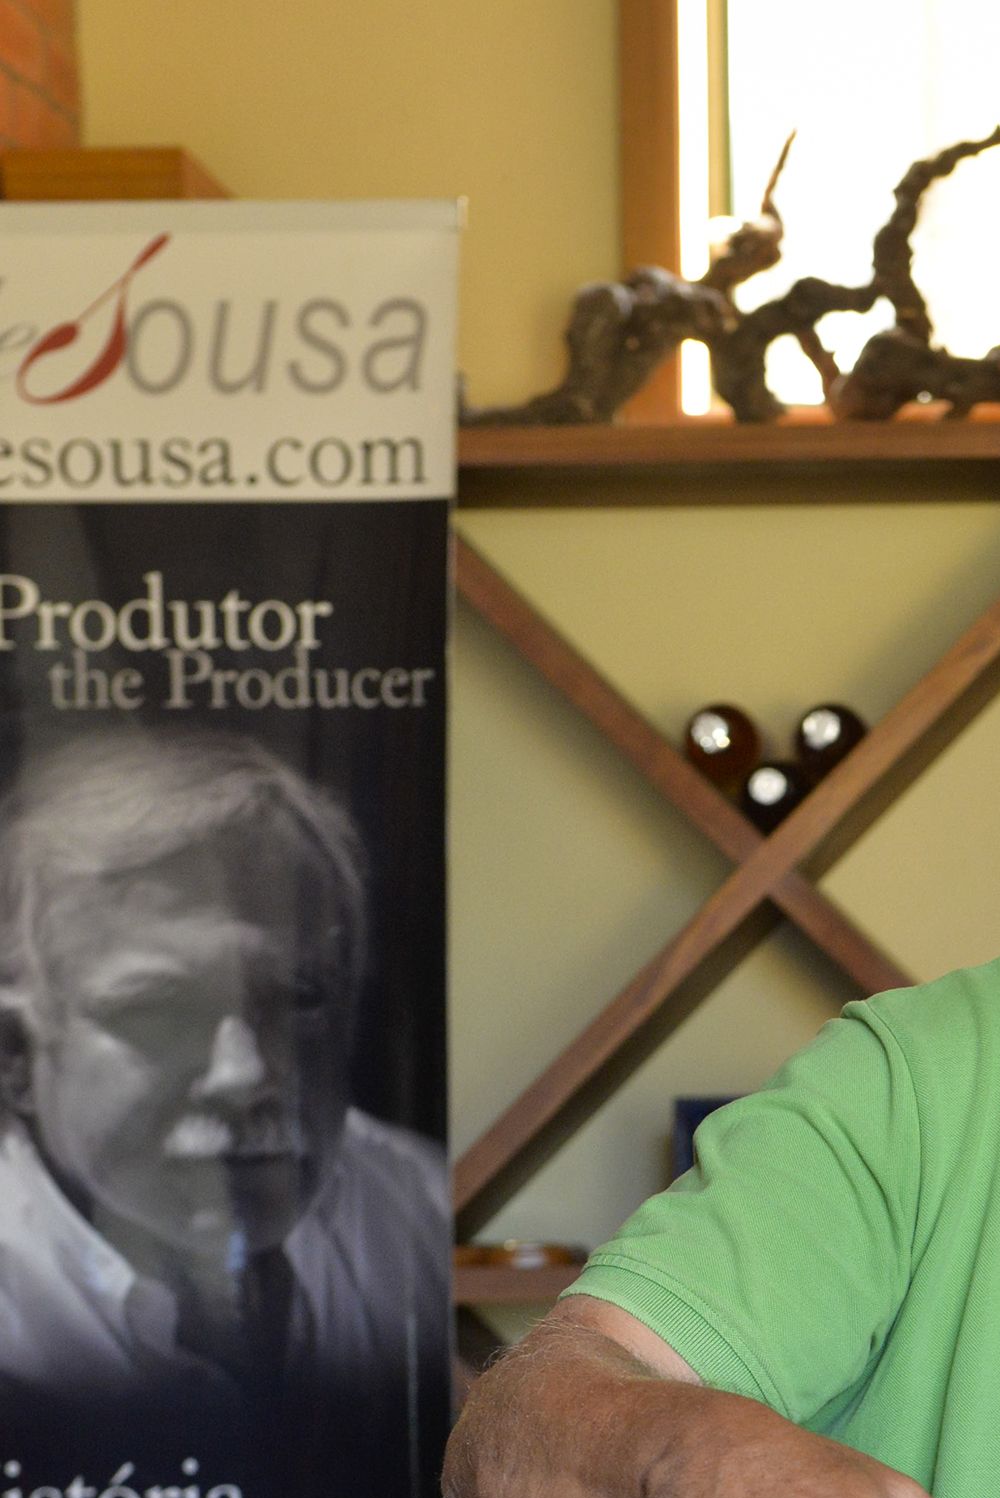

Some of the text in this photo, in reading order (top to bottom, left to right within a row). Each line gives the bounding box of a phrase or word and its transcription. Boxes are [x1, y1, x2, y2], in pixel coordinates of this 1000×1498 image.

[0, 570, 334, 651] Produtor
[48, 644, 435, 709] the Producer
